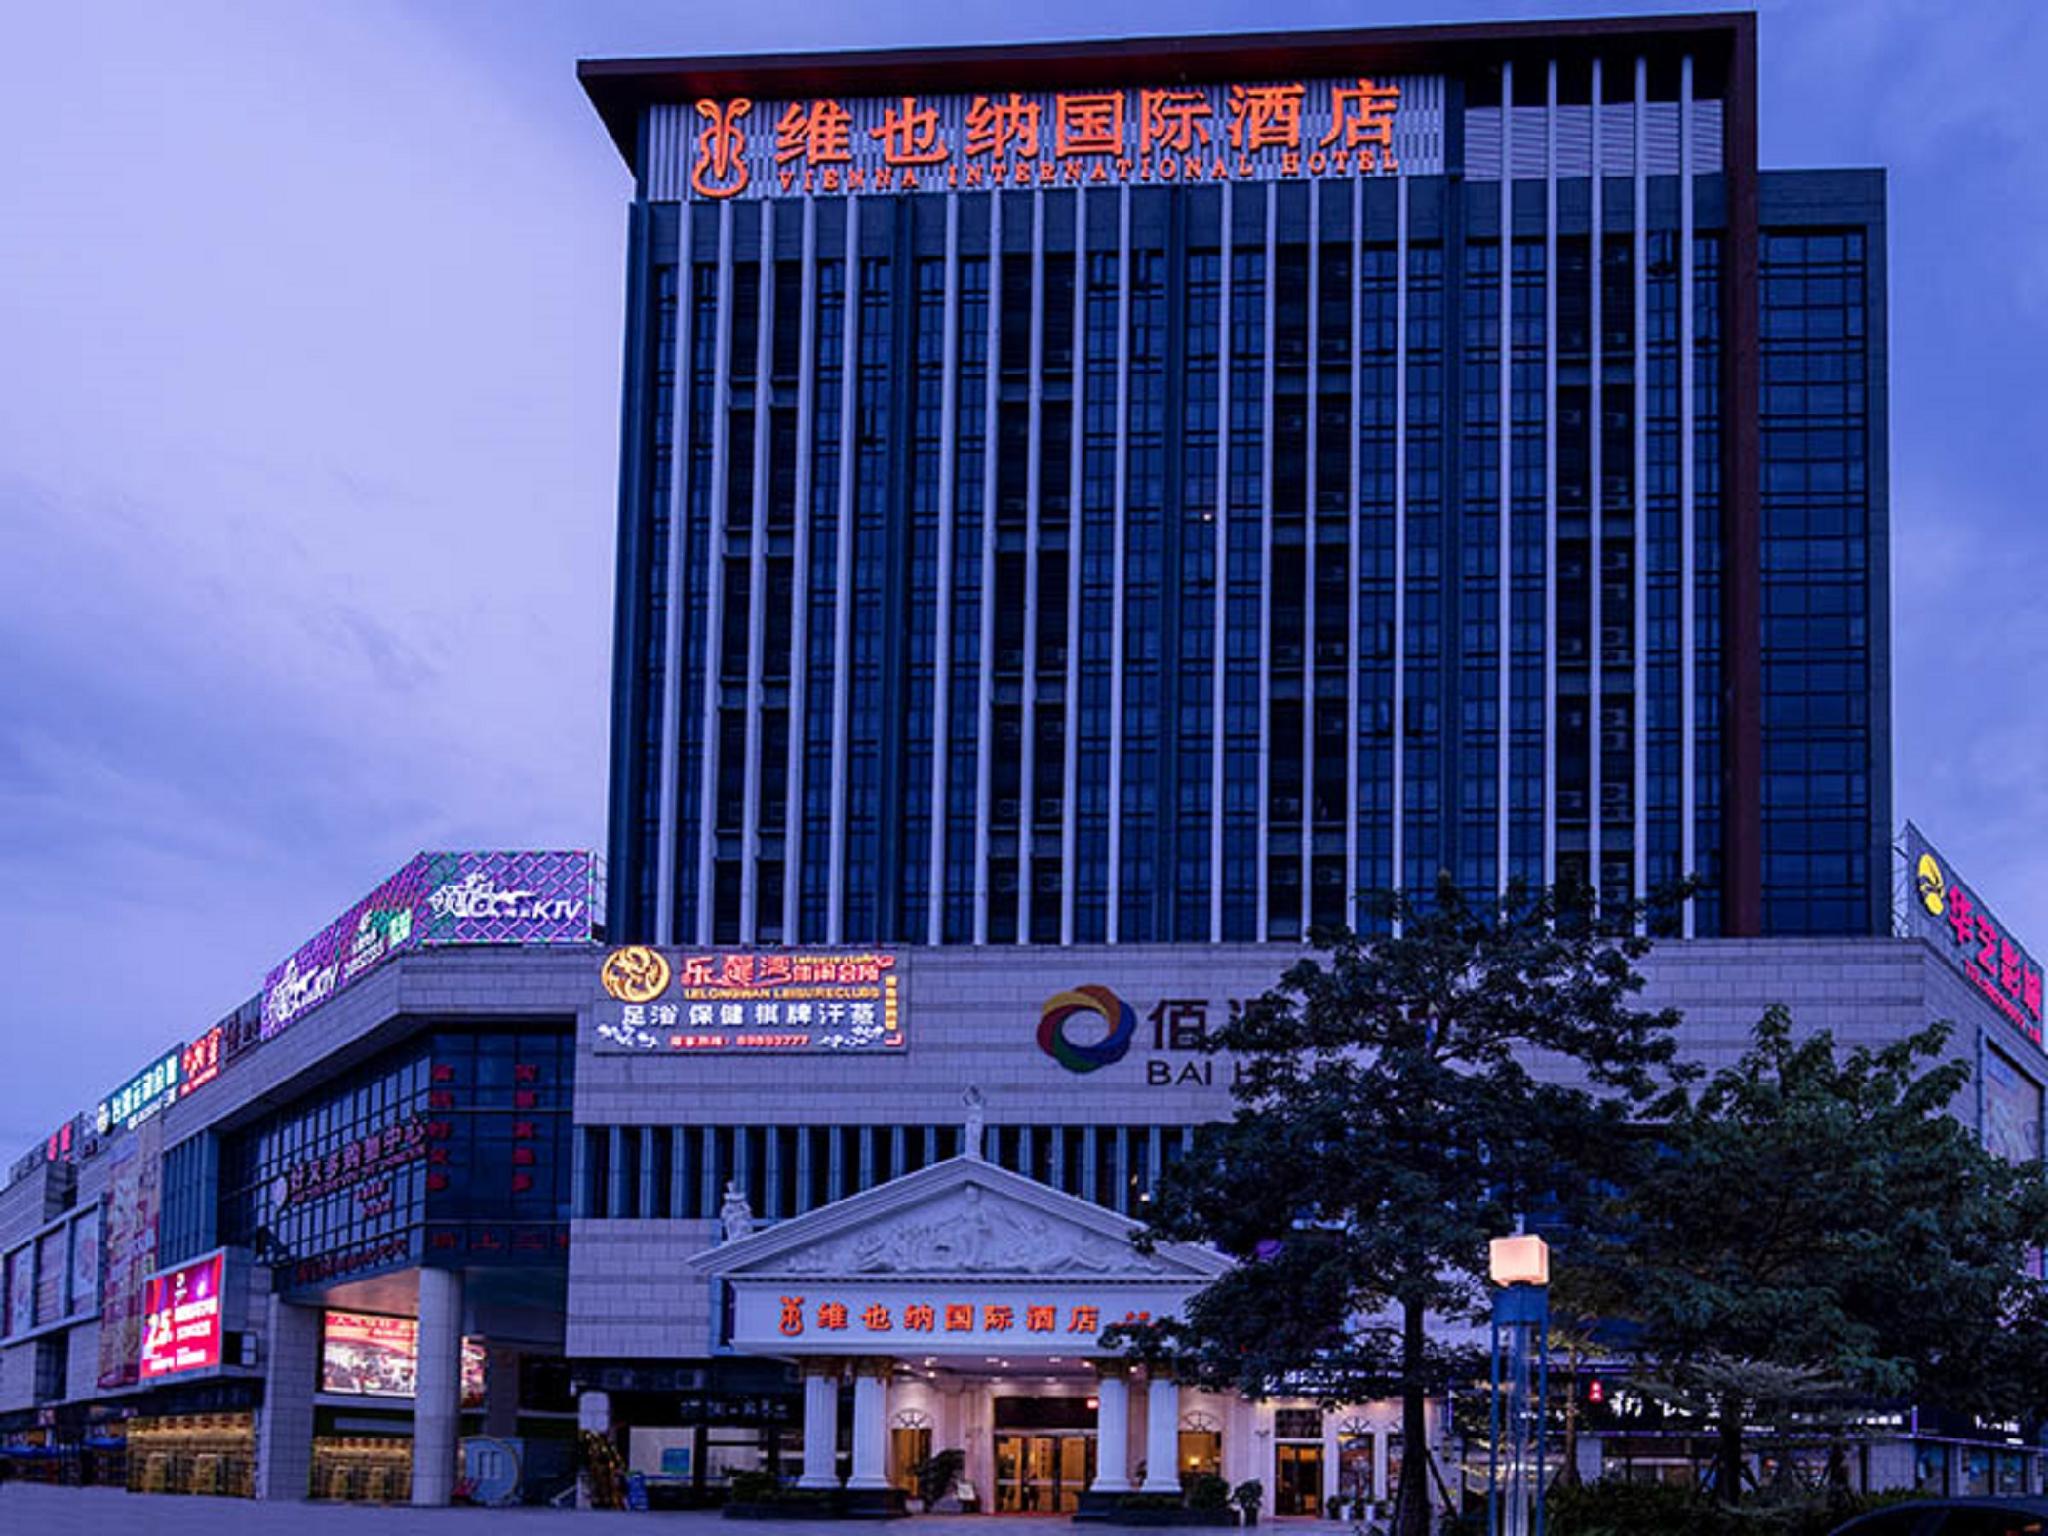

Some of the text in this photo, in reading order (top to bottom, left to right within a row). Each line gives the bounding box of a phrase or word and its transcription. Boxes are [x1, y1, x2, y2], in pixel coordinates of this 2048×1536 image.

[774, 79, 1401, 166] 维也纳国际酒店
[777, 148, 1399, 191] VIENNA INTERNATIONAL HOTEL
[532, 898, 584, 921] KTV
[1147, 1060, 1212, 1086] BAI
[816, 1302, 1098, 1333] 维也纳国际酒店
